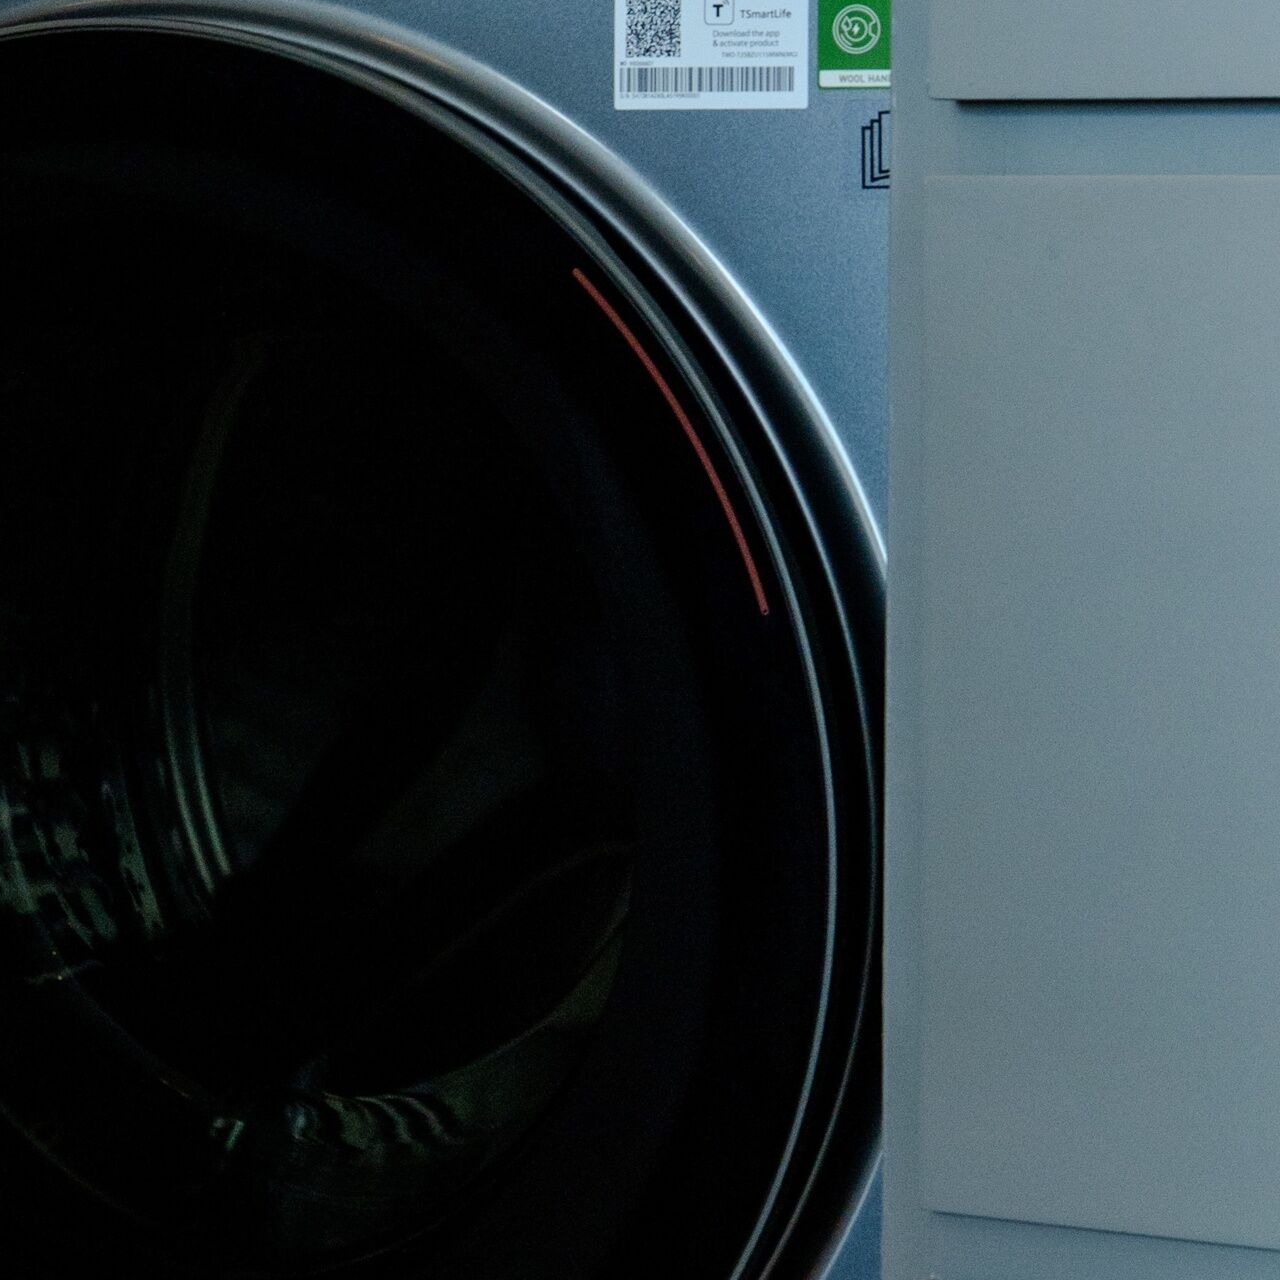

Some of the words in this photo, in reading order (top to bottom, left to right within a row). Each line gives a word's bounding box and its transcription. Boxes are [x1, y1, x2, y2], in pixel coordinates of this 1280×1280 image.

[740, 8, 792, 19] TSmartLife
[712, 30, 750, 38] Download
[751, 29, 763, 37] the
[765, 30, 780, 39] app
[719, 39, 748, 47] activate
[749, 39, 780, 48] product
[839, 74, 865, 83] WOOL
[868, 73, 891, 82] HAN
